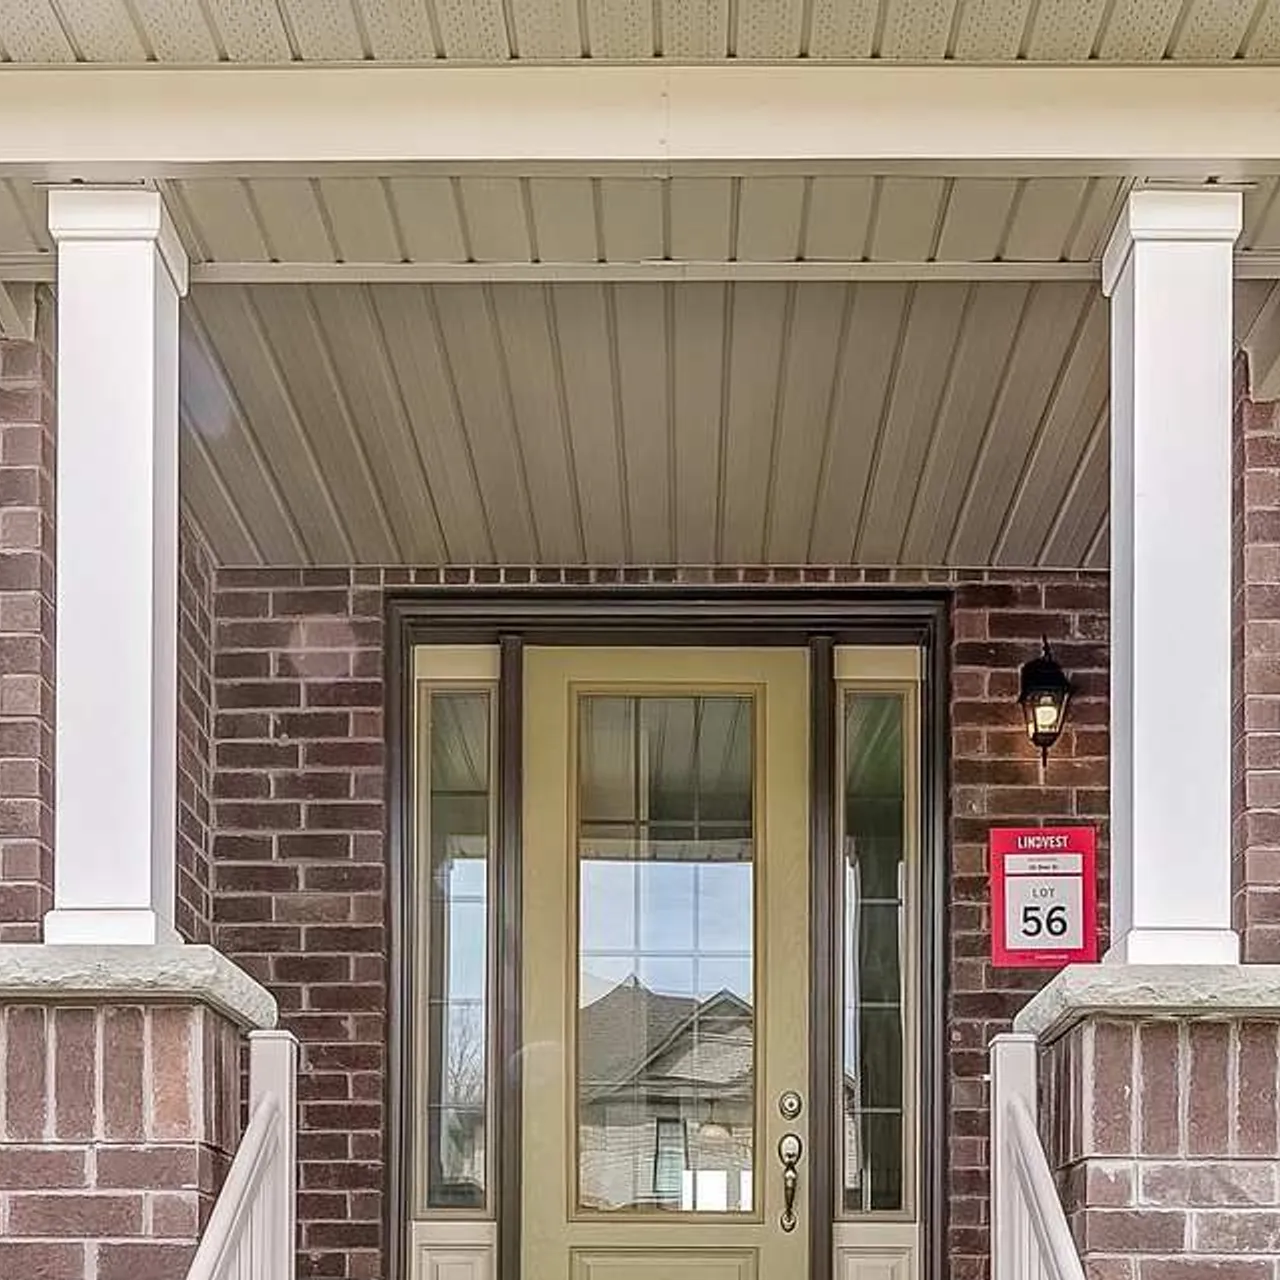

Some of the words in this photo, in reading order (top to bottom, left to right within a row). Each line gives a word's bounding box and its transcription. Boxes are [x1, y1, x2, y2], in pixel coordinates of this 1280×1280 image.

[1017, 835, 1069, 849] LINDVEST
[1031, 888, 1056, 898] LOT
[1021, 906, 1068, 937] 56
